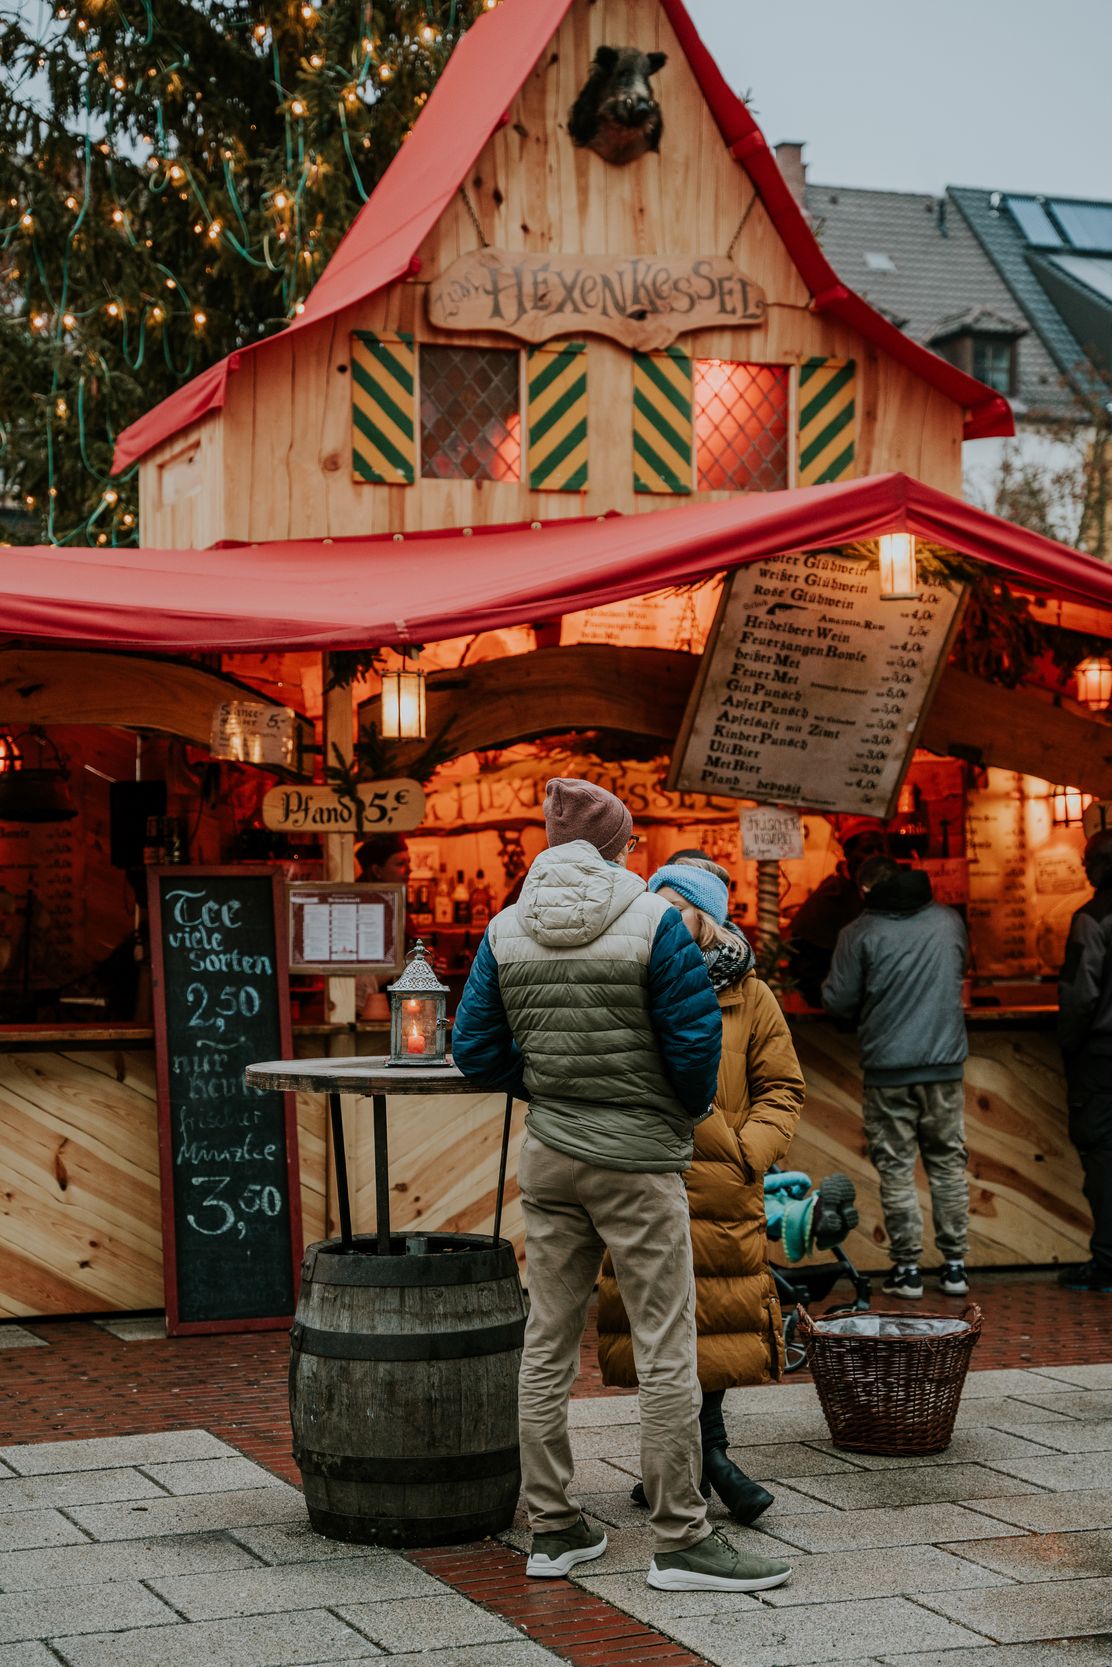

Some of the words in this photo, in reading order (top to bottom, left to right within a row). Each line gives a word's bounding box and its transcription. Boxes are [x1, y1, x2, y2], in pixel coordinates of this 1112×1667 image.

[790, 587, 854, 610] Glühwein
[804, 573, 869, 594] Glühwein
[807, 723, 841, 739] Zimt
[277, 790, 353, 828] Pfand
[165, 889, 242, 928] Tee
[168, 926, 224, 951] viele
[185, 981, 260, 1033] 2,50
[186, 1176, 282, 1240] 3,50
